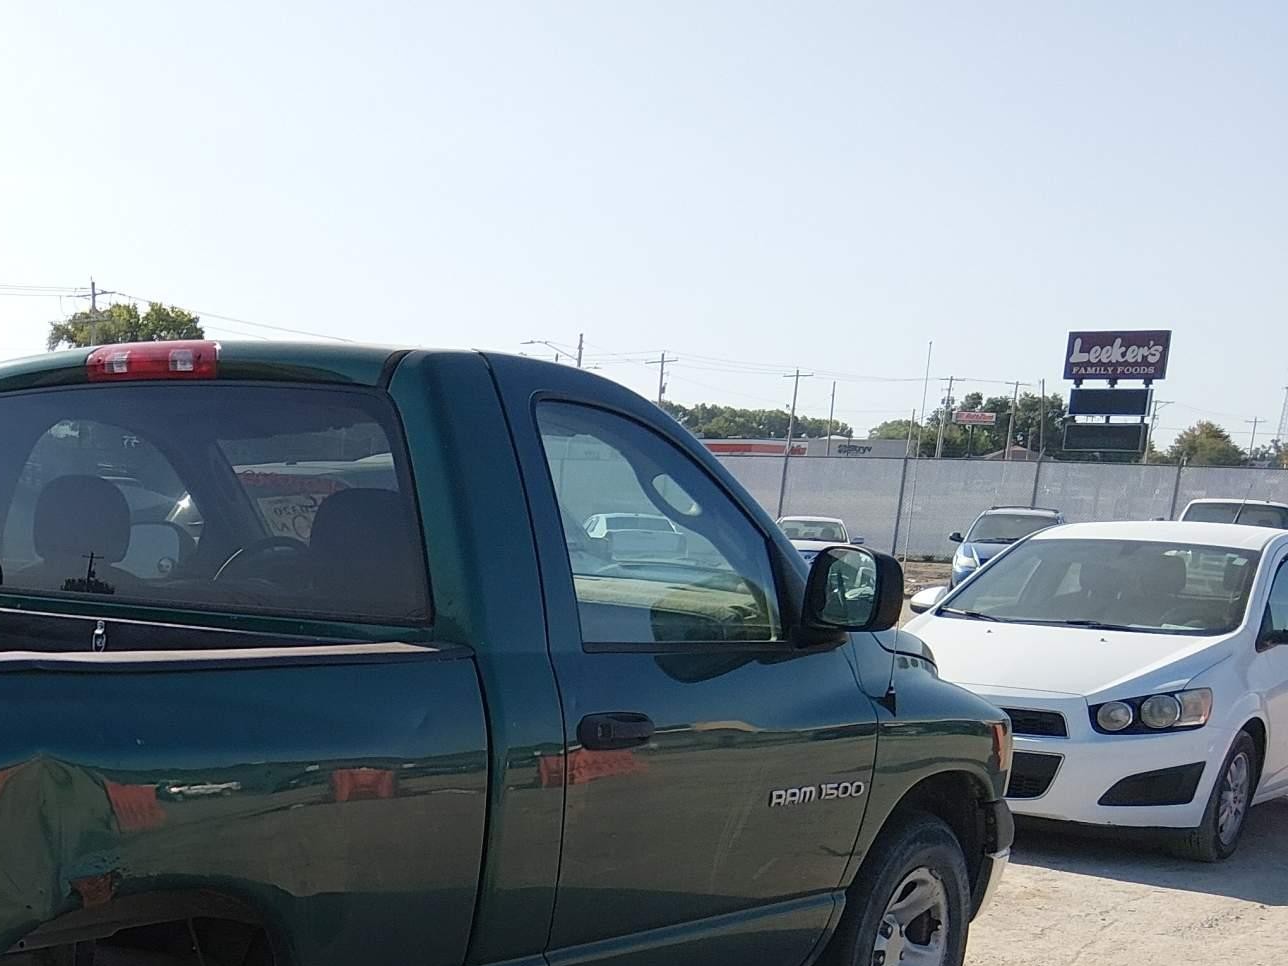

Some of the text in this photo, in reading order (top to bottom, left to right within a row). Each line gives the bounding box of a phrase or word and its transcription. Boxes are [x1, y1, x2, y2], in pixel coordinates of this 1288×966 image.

[1069, 337, 1163, 363] Leeker's
[1072, 366, 1155, 374] FAMILY FOODS
[770, 781, 865, 807] RAM 1500
